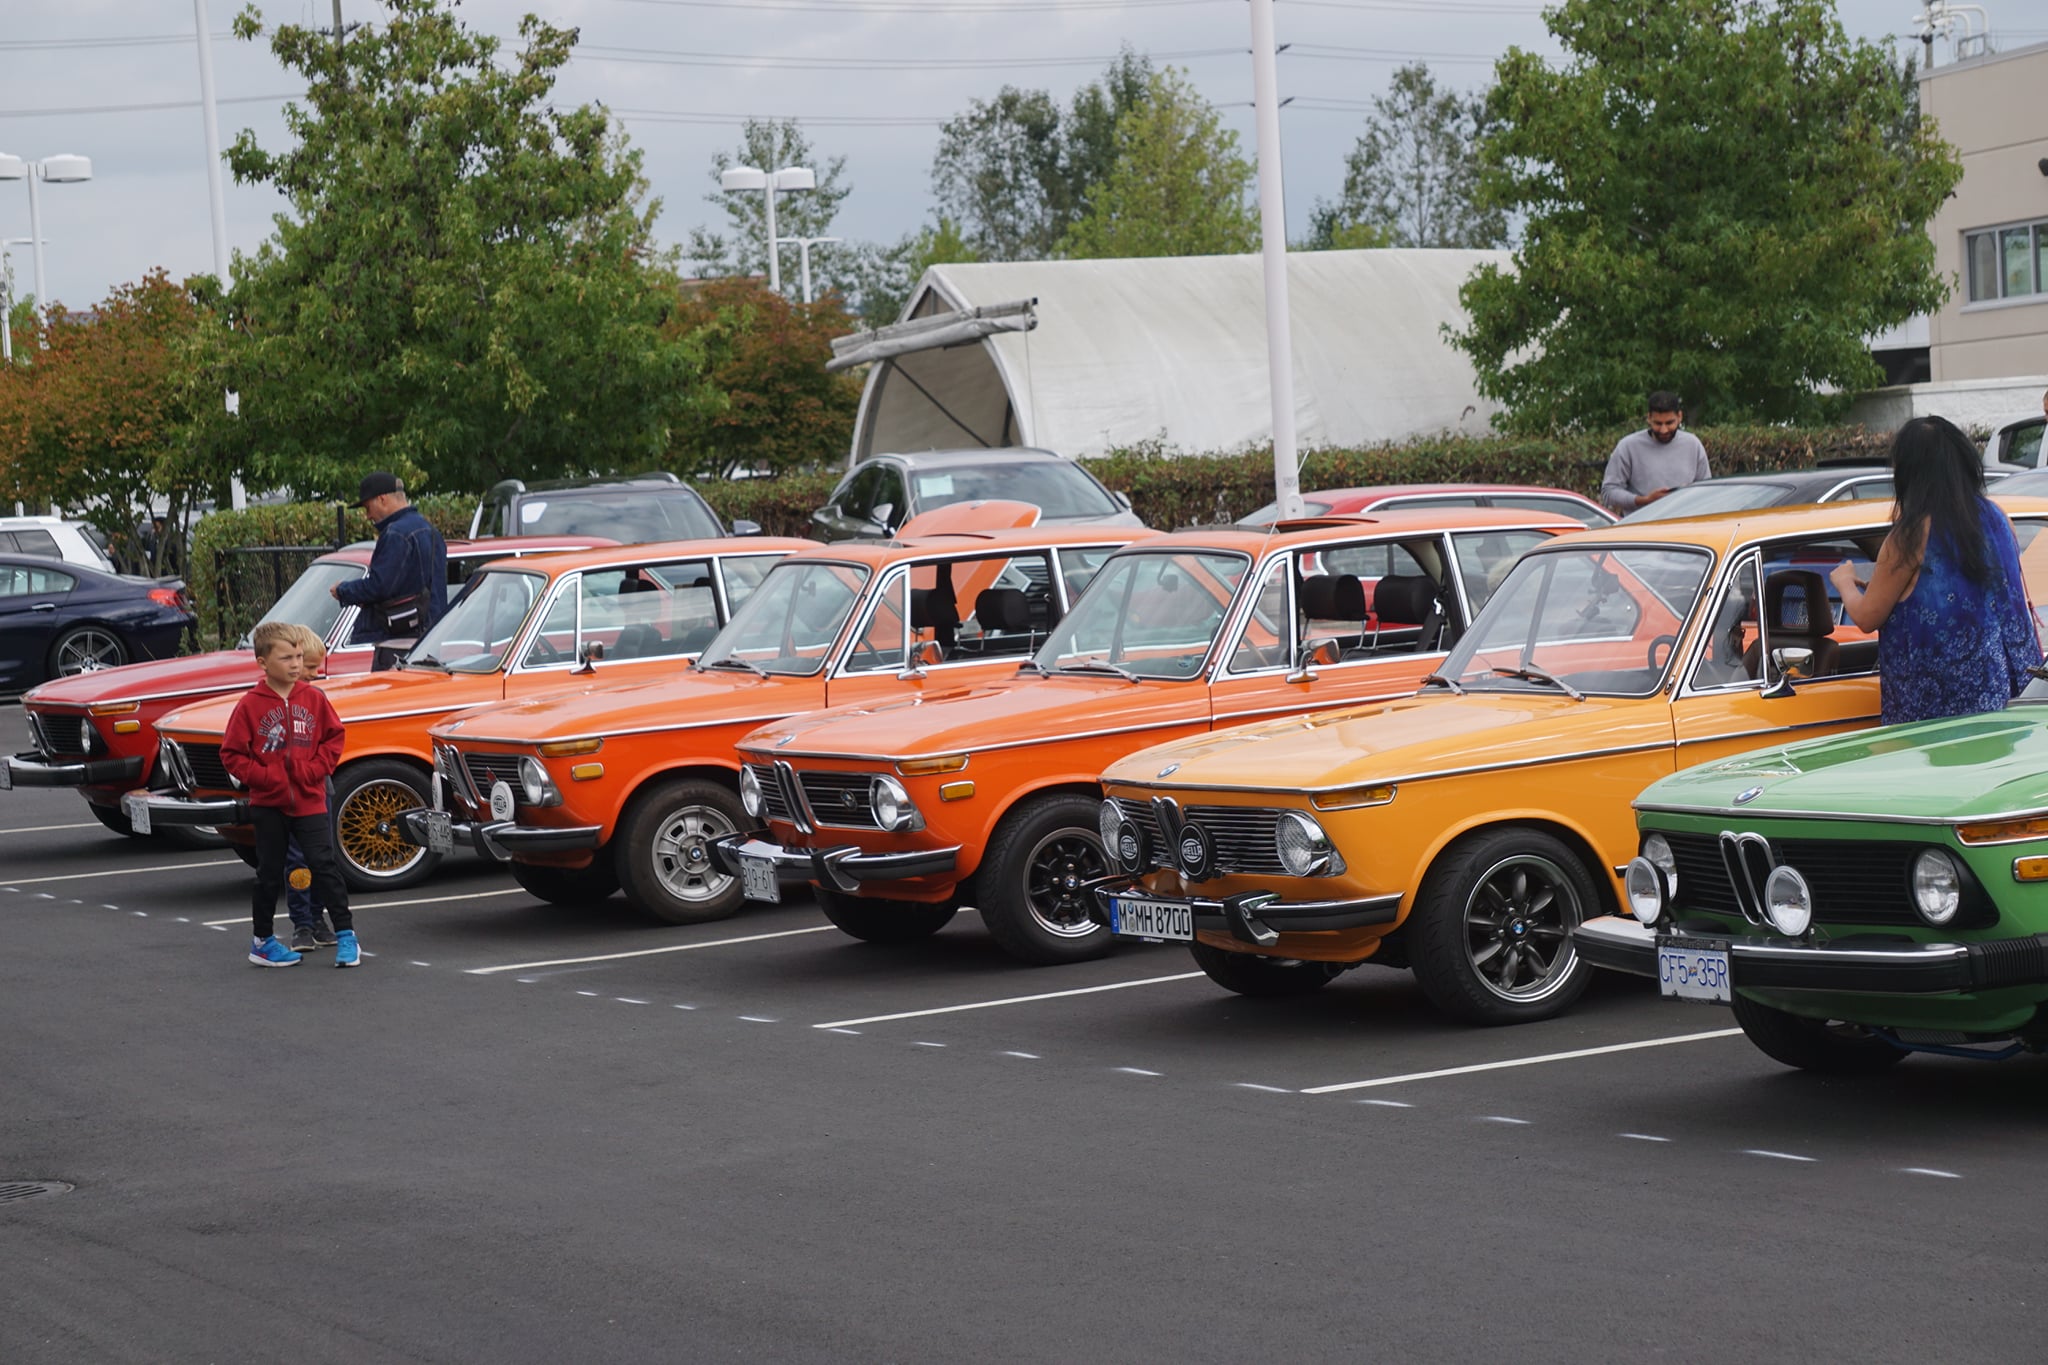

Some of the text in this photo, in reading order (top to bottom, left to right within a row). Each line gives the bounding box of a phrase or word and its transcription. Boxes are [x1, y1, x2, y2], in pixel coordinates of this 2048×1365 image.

[1182, 844, 1203, 857] HELLA
[1118, 903, 1190, 936] M MH 8700
